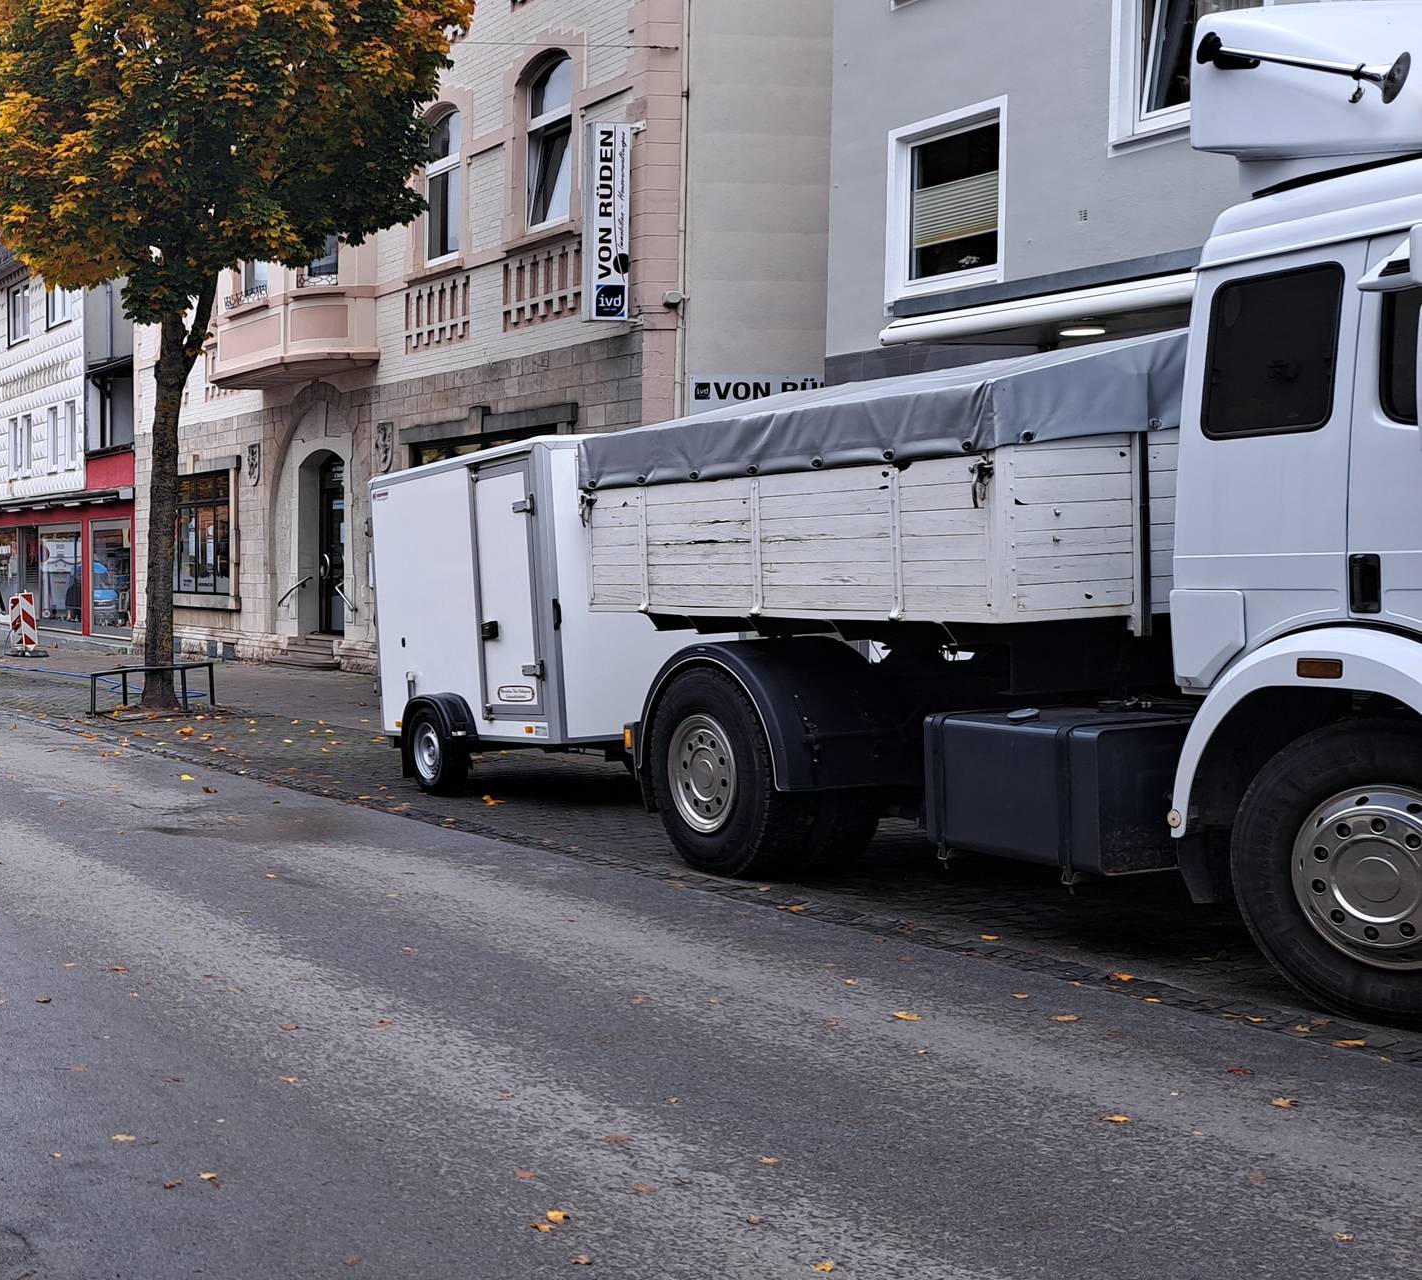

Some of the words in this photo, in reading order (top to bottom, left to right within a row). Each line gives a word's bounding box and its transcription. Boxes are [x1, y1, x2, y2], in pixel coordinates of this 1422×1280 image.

[596, 130, 614, 218] RÜDEN
[598, 227, 613, 280] VON
[598, 294, 622, 307] ivd
[713, 381, 771, 400] VON
[781, 377, 825, 393] RÜ
